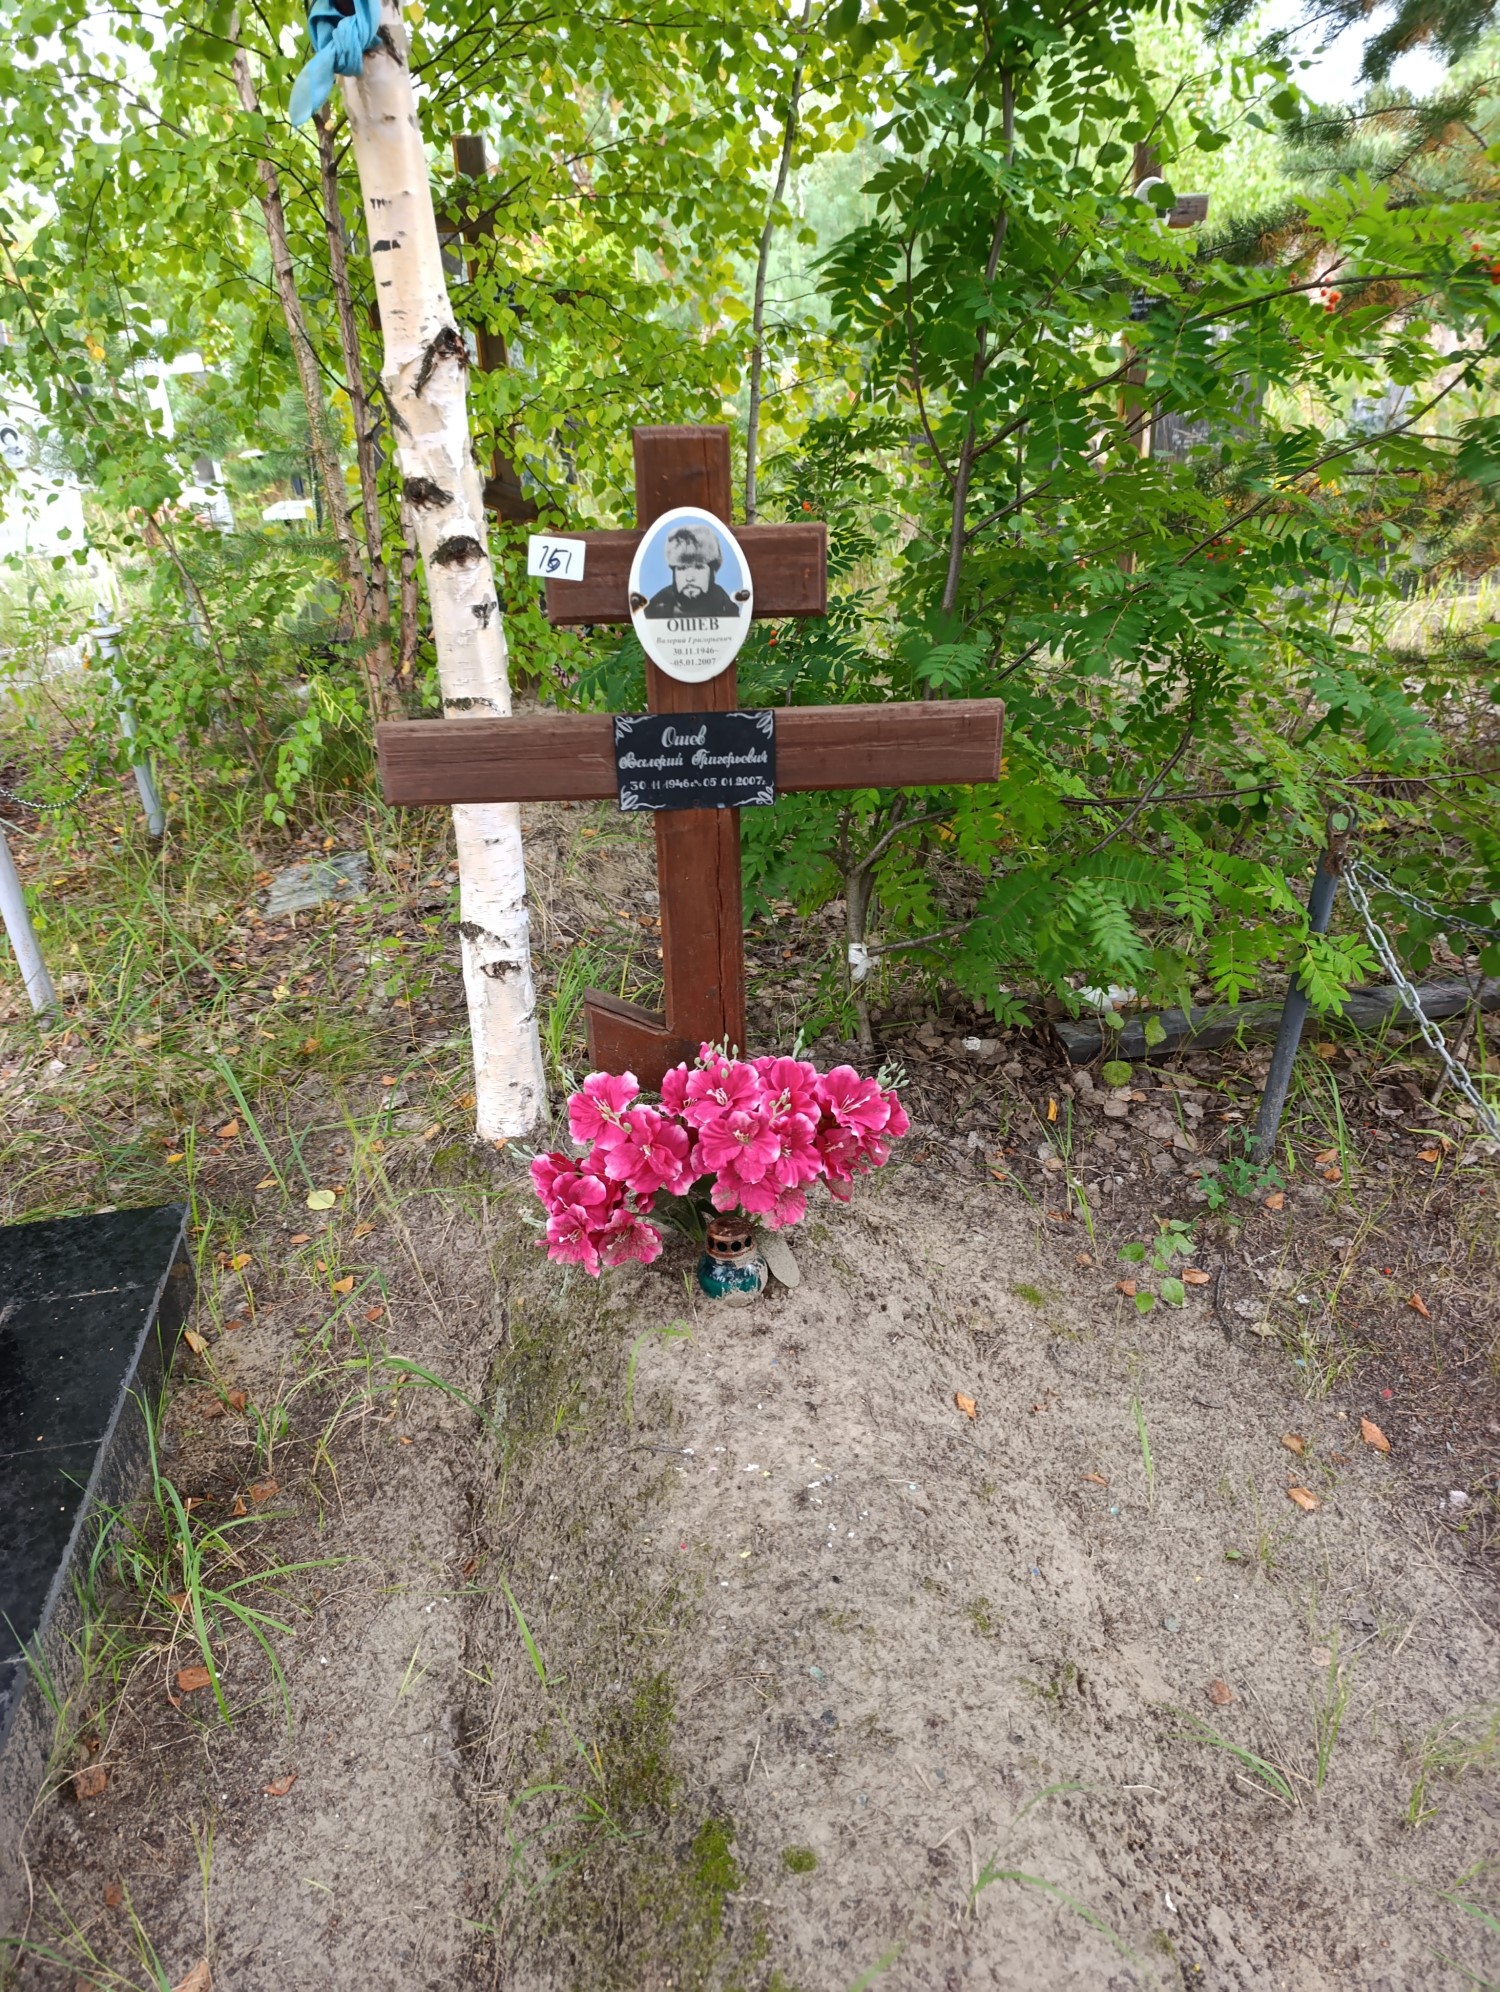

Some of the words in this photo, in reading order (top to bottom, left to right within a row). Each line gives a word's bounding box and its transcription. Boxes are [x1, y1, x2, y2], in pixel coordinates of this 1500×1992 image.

[667, 617, 719, 632] ОШЕВ
[661, 724, 707, 748] Ошев
[618, 751, 684, 771] Валерий
[691, 747, 768, 769] Григорьевич
